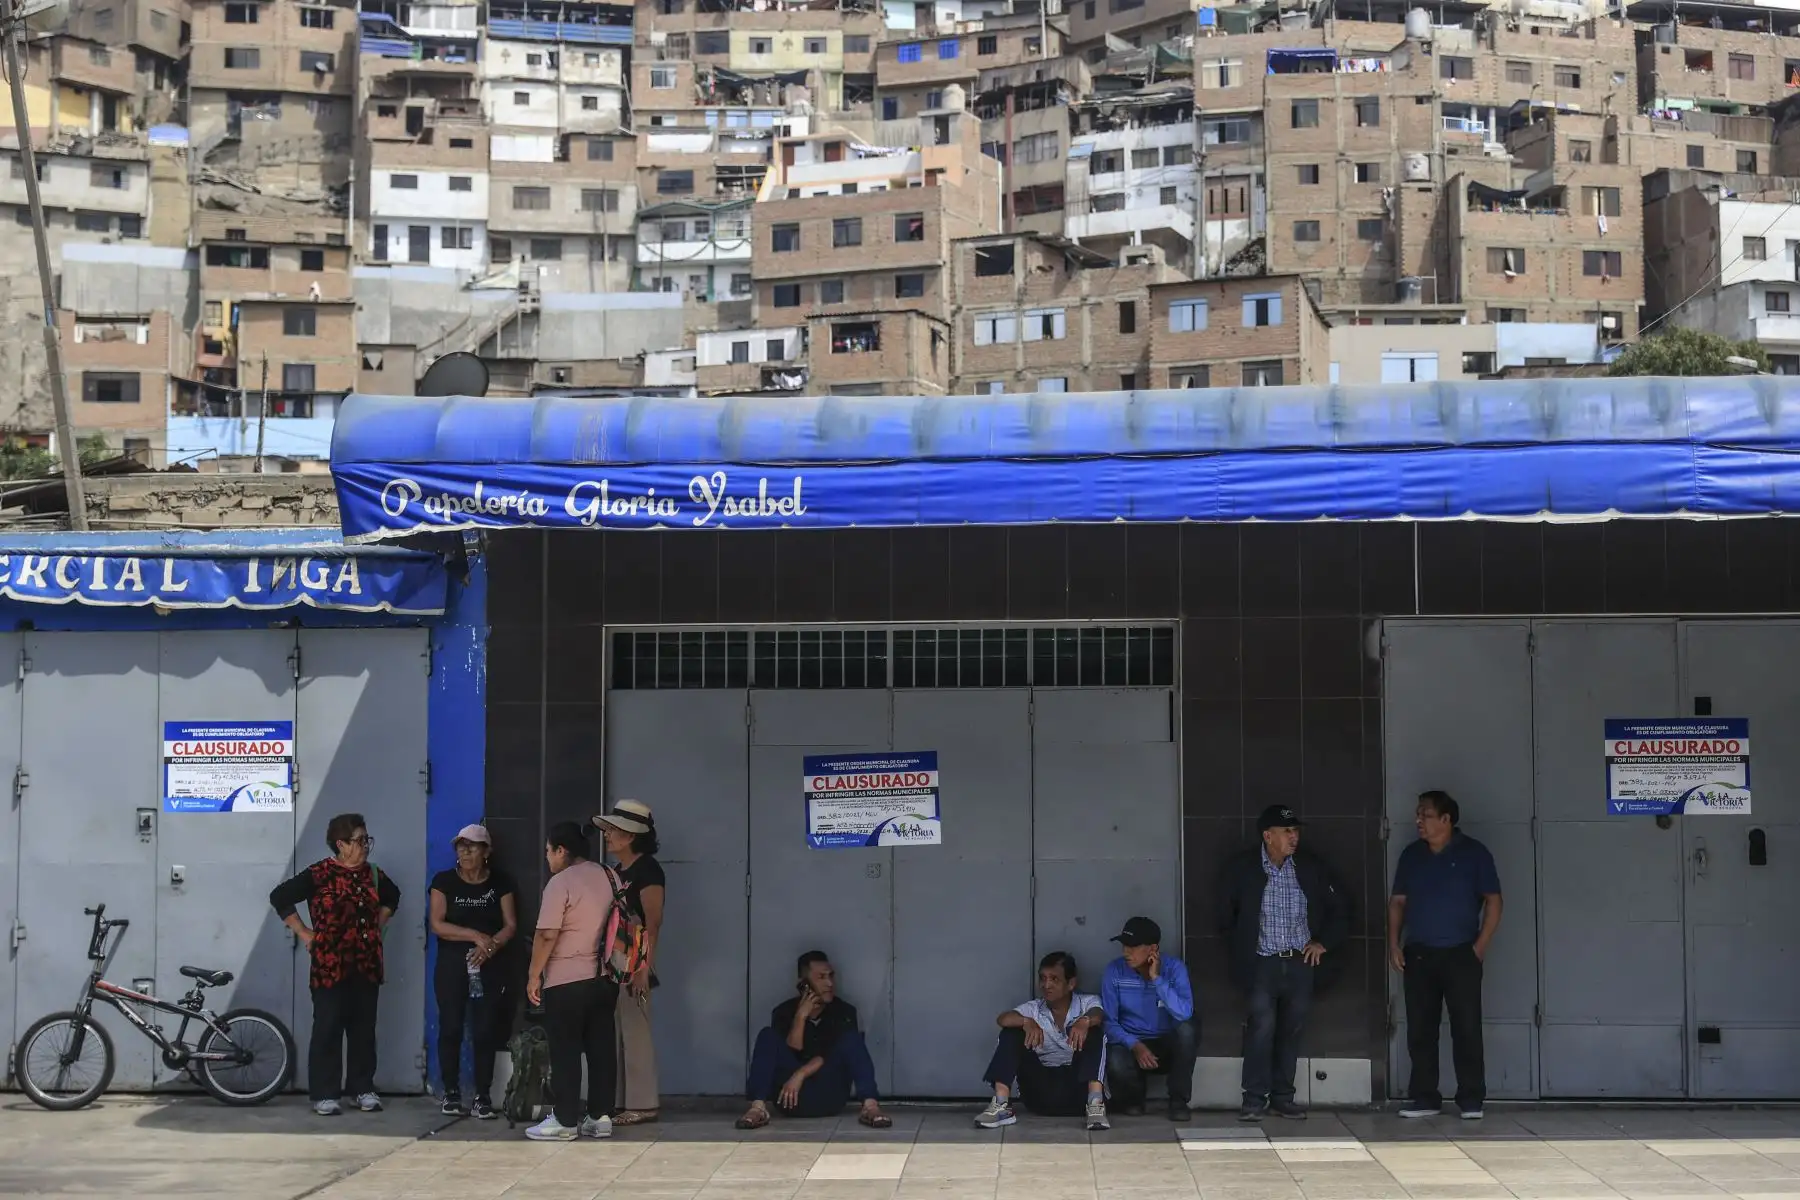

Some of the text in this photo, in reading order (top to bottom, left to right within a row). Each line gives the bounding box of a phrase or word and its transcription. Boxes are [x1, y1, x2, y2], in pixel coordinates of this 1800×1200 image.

[381, 471, 807, 526] Papelería Gloria Ysabel
[244, 556, 361, 594] INGA
[172, 742, 284, 755] CLAUSURADO
[1614, 740, 1740, 754] CLAUSURADO
[812, 773, 930, 790] CLAUSURADO
